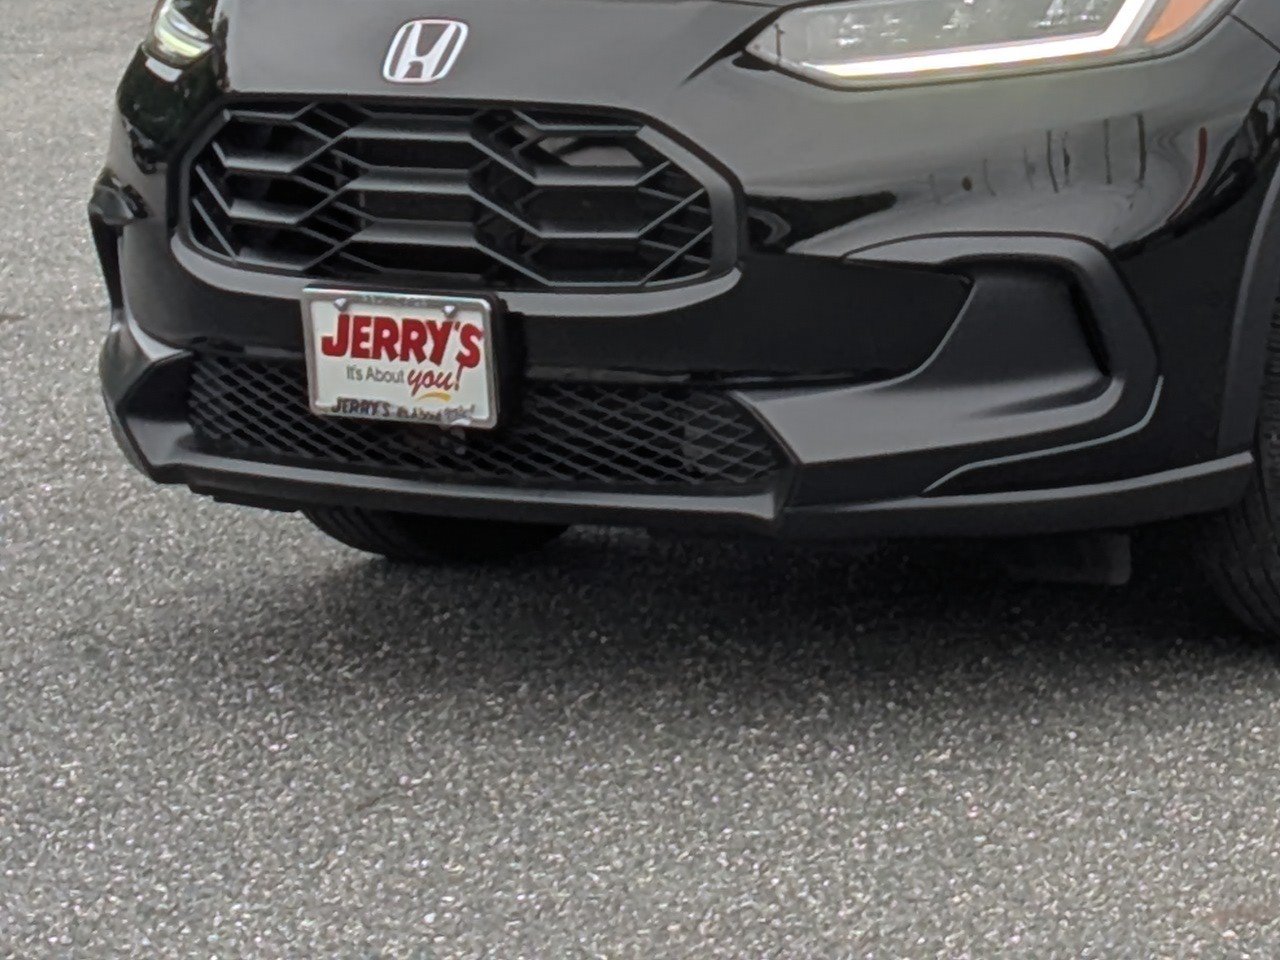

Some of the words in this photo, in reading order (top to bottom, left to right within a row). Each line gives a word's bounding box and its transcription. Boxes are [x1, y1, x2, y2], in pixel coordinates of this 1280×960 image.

[321, 313, 485, 369] JERRY'S
[346, 364, 363, 381] It's
[366, 366, 404, 384] About
[407, 364, 464, 397] you!
